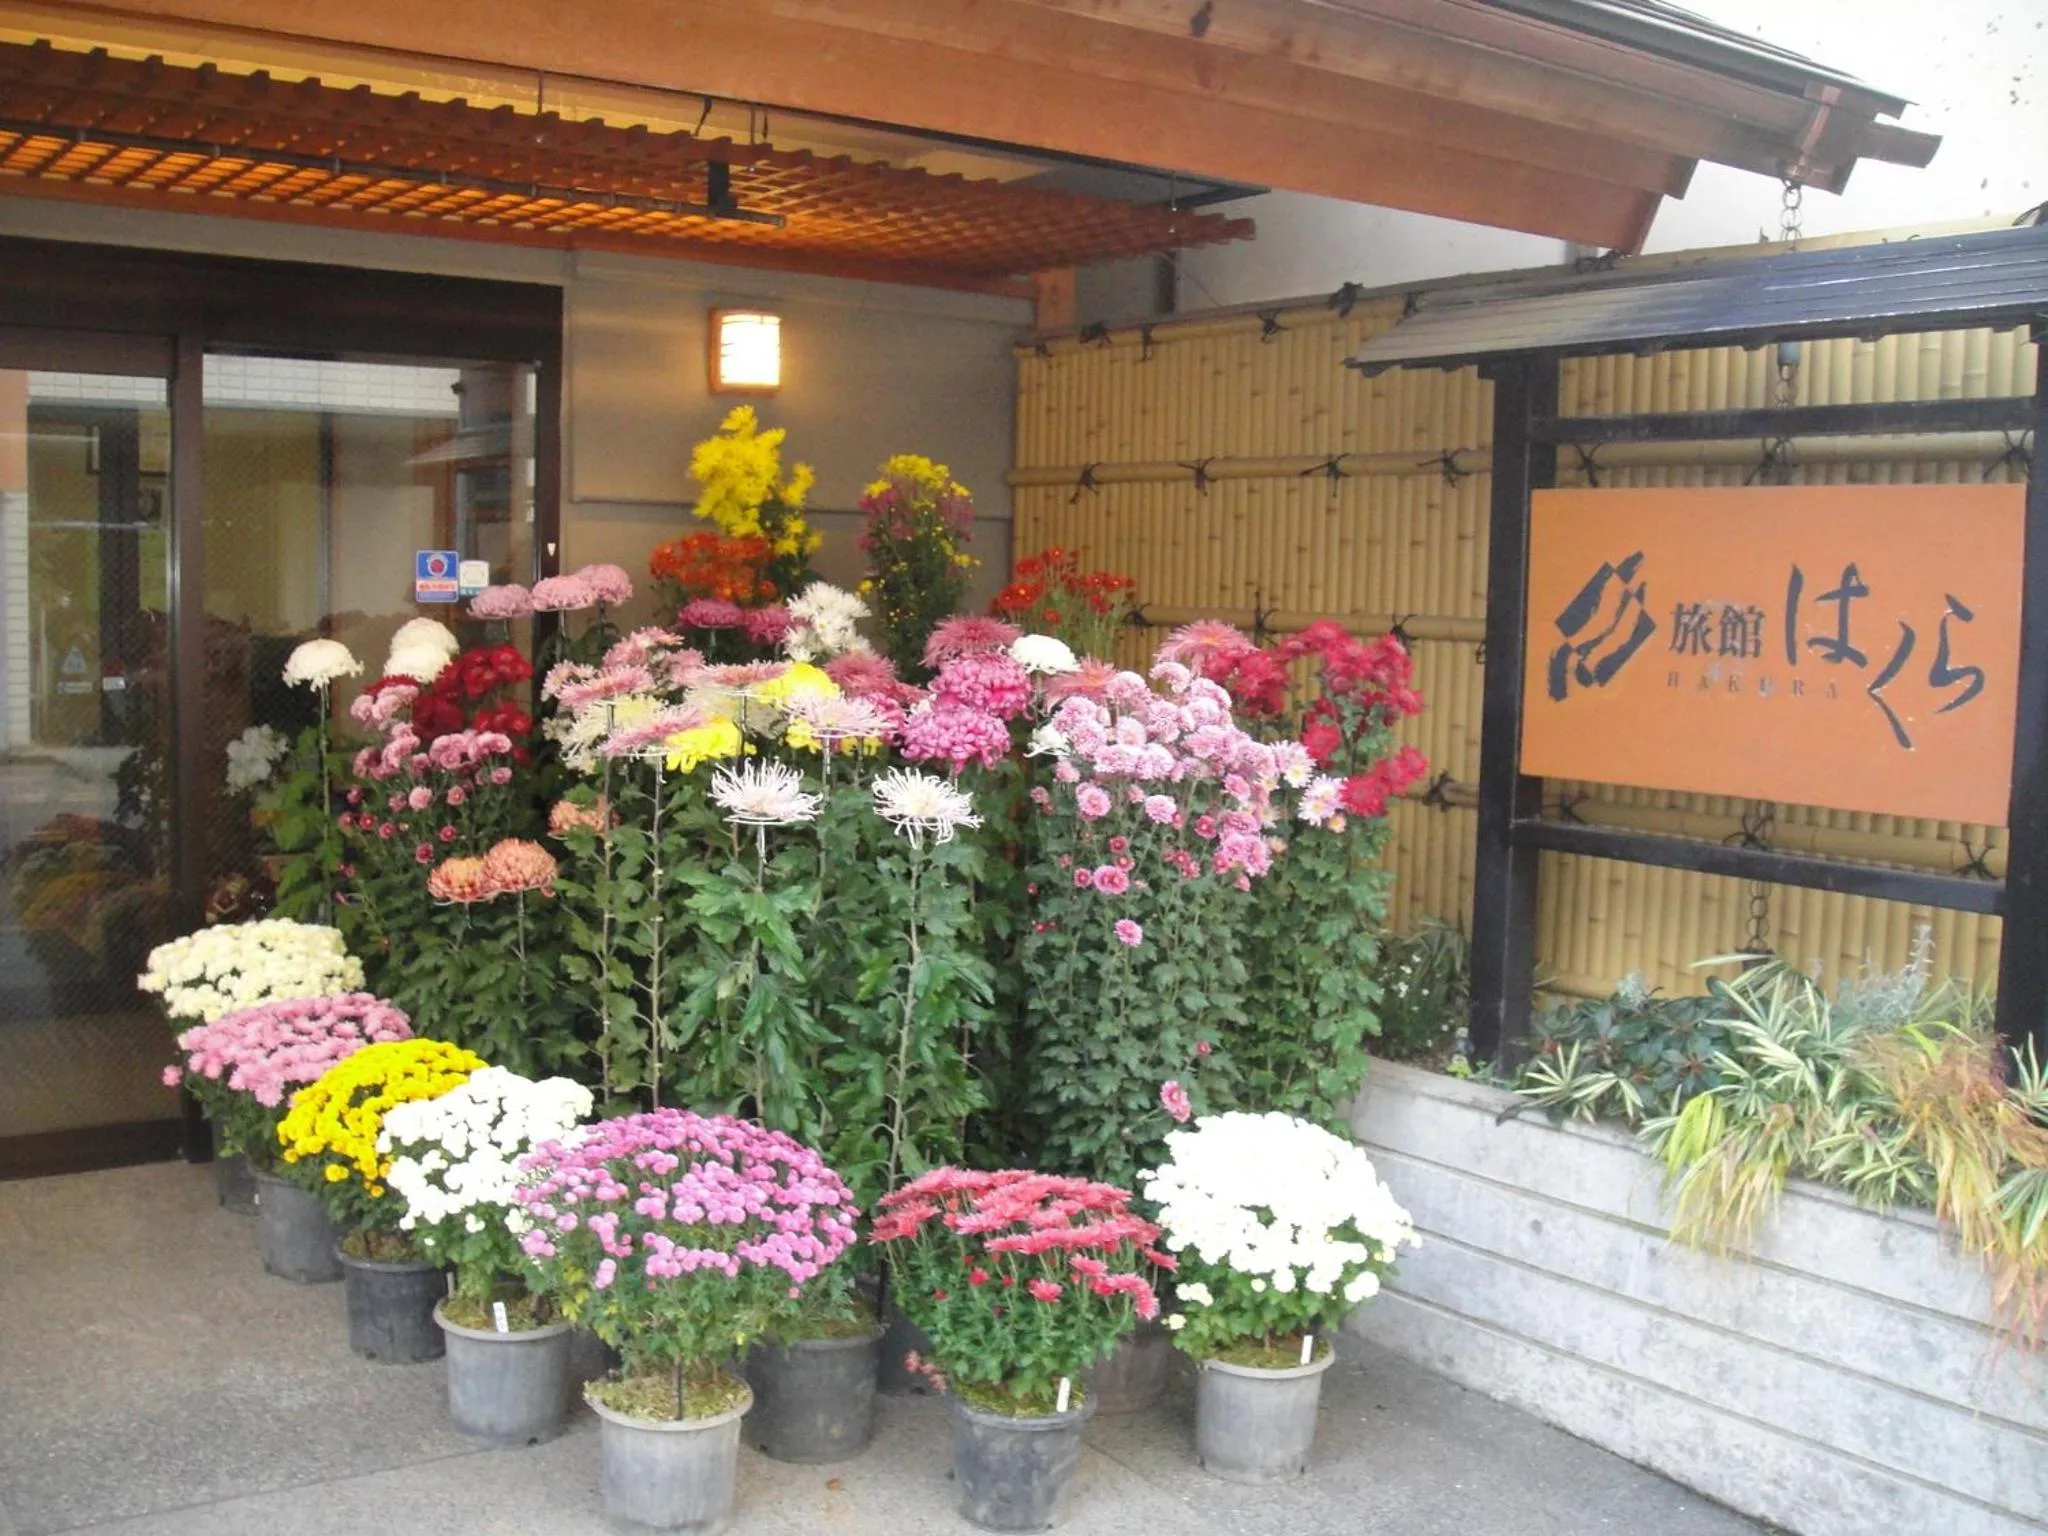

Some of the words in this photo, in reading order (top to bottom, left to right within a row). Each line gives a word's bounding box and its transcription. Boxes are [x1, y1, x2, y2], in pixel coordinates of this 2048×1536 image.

[1667, 671, 1838, 699] HAKURA
[1669, 603, 1765, 658] 旅館
[1785, 562, 1985, 748] はくら
